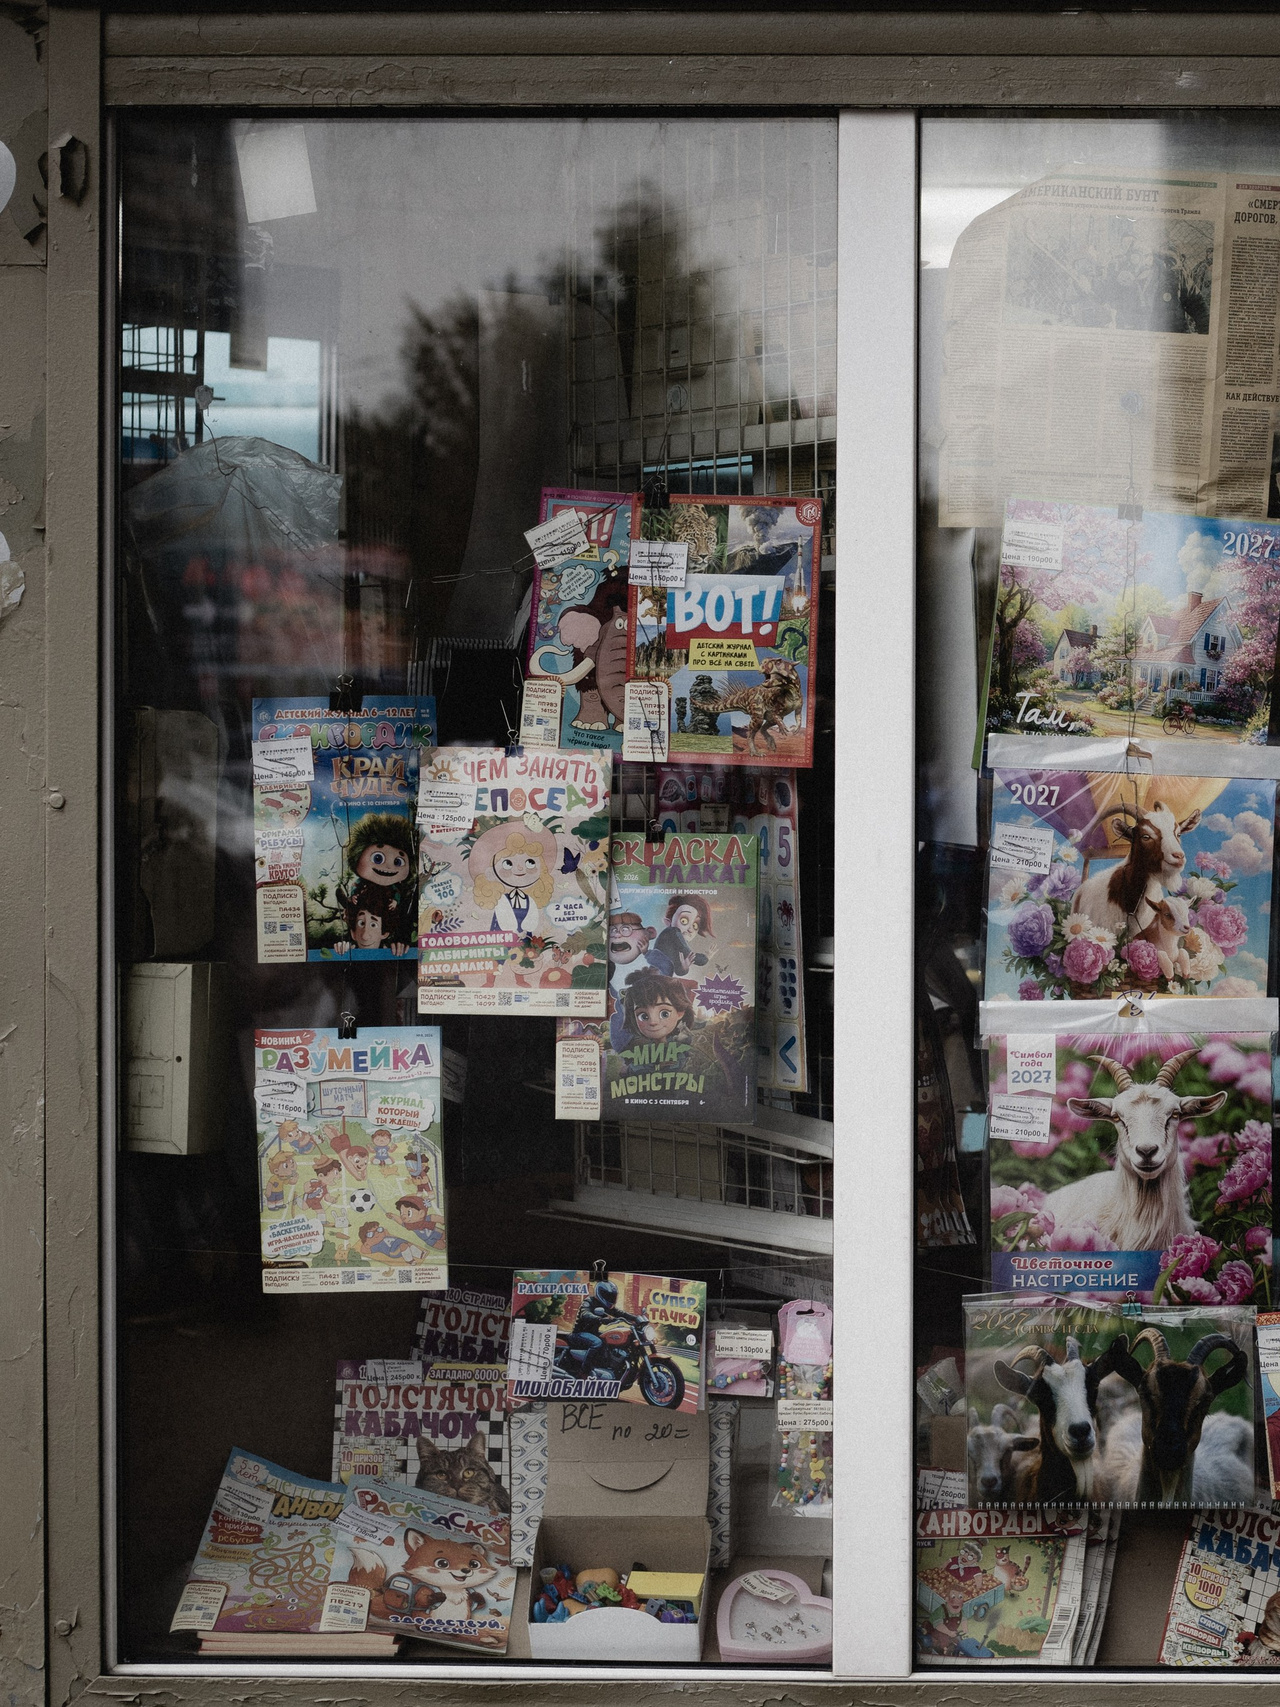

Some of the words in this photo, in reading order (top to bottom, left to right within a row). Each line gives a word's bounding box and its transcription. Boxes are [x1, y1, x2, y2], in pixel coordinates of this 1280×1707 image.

[1020, 184, 1123, 202] АМЕРИКАНСКИЙ
[1126, 188, 1160, 203] БУНТ
[1234, 212, 1278, 226] ДОРОГОВ,
[1225, 391, 1241, 401] КАК
[1222, 531, 1275, 559] 2027
[673, 581, 779, 636] ВОТ!
[696, 641, 724, 650] ДЕТСКИЙ
[707, 651, 747, 659] КАРТИНКАМИ
[734, 660, 755, 668] СВЕТЕ
[274, 708, 321, 719] ДЕТСКИЙ
[399, 708, 416, 718] ЛЕТ
[1015, 692, 1075, 732] Там,
[331, 754, 405, 779] КРАЙ
[463, 756, 508, 783] ЧЕМ
[516, 754, 598, 784] ЗАНЯТЬ
[329, 778, 408, 798] ЧУДЕС
[1010, 784, 1060, 806] 2027
[475, 783, 598, 812] ЕПОСЕДУ
[417, 811, 436, 820] Цена
[648, 865, 750, 884] ПЛАКАТ
[554, 915, 588, 923] ГАДЖЕТОВ
[421, 932, 514, 947] ГОЛОВОЛОМКИ
[429, 947, 505, 962] ЛАБИРИНТЫ
[420, 961, 494, 976] НАХОДИЛКИ
[420, 993, 456, 1001] ПОДПИСКУ
[261, 1035, 302, 1046] НОВИНКА
[262, 1040, 431, 1075] РАЗУМЕЙКА
[632, 1042, 679, 1067] МИА
[1010, 1050, 1052, 1060] Символ
[1020, 1059, 1043, 1068] года
[1011, 1070, 1052, 1084] 2027
[610, 1072, 705, 1099] МОНСТРЫ
[377, 1106, 419, 1118] КОТОРЫЙ
[375, 1117, 388, 1125] ТЫ
[990, 1126, 1010, 1135] Цена
[1011, 1257, 1113, 1271] Цветочное
[1012, 1273, 1139, 1288] НАСТРОЕНИЕ
[518, 1283, 589, 1295] РАСКРАСКА
[651, 1291, 697, 1309] СУПЕР
[649, 1307, 699, 1326] ТАЧКИ
[1260, 1360, 1279, 1369] Цена
[430, 1369, 472, 1381] ЗАГАДАНО
[474, 1370, 499, 1381] 8000
[513, 1376, 621, 1399] МОТОБАЙКИ
[344, 1410, 481, 1439] КАБАЧОК
[560, 1402, 607, 1434] ВСЕ
[612, 1426, 631, 1441] по
[341, 1450, 353, 1462] 10
[354, 1453, 384, 1463] ПРИЗОВ
[355, 1489, 506, 1545] РАСКРАСКА
[1189, 1562, 1201, 1576] 10
[1201, 1569, 1229, 1586] ПРИЗОВ
[1187, 1574, 1198, 1585] ПО
[1198, 1579, 1222, 1598] 1000
[1194, 1590, 1220, 1607] РУБЛЕЙ
[1199, 1616, 1226, 1634] СУДОКУ
[1178, 1623, 1221, 1645] ФИЛВОРДЫ
[1183, 1643, 1225, 1657] КЕЙВОРДЫ
